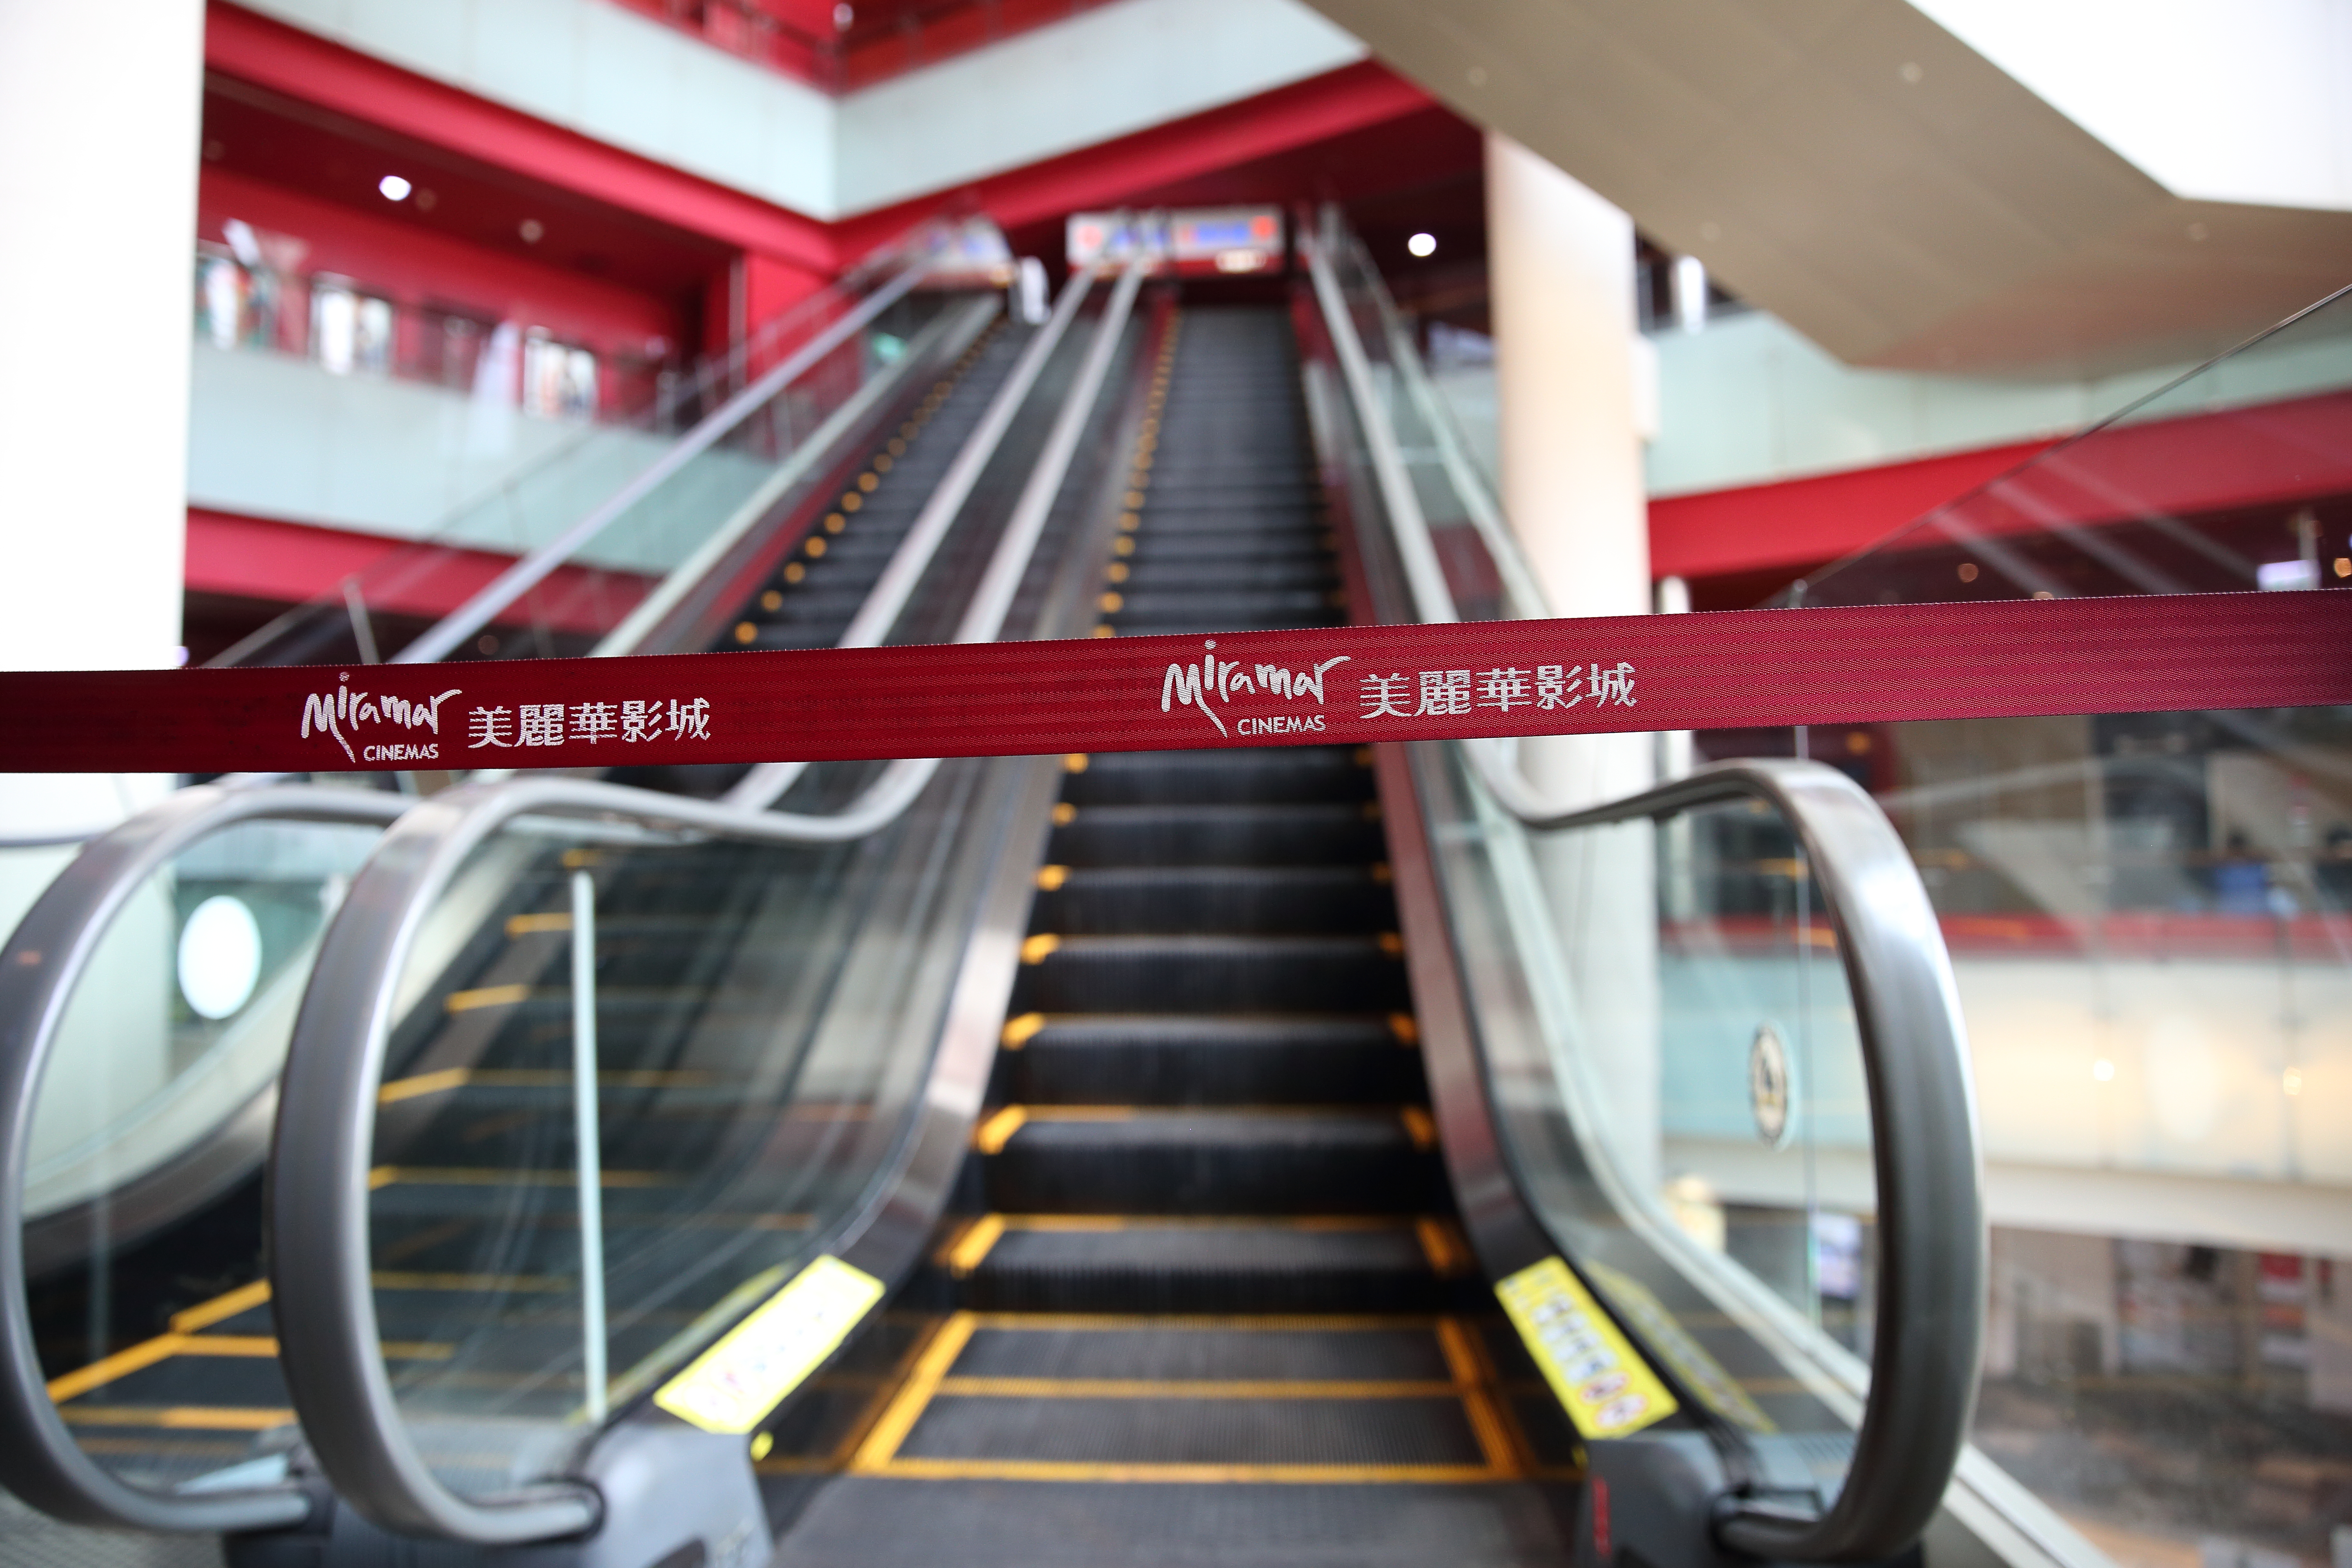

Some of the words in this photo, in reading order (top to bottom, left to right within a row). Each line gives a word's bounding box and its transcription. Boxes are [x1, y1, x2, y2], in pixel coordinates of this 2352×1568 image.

[1161, 639, 1351, 737] Miramar
[1359, 662, 1637, 719] 美麗華影城
[301, 672, 462, 763] Miramar
[468, 697, 711, 749] 美麗華影城
[1237, 715, 1326, 735] CINEMAS
[363, 743, 439, 762] CINEMAS
